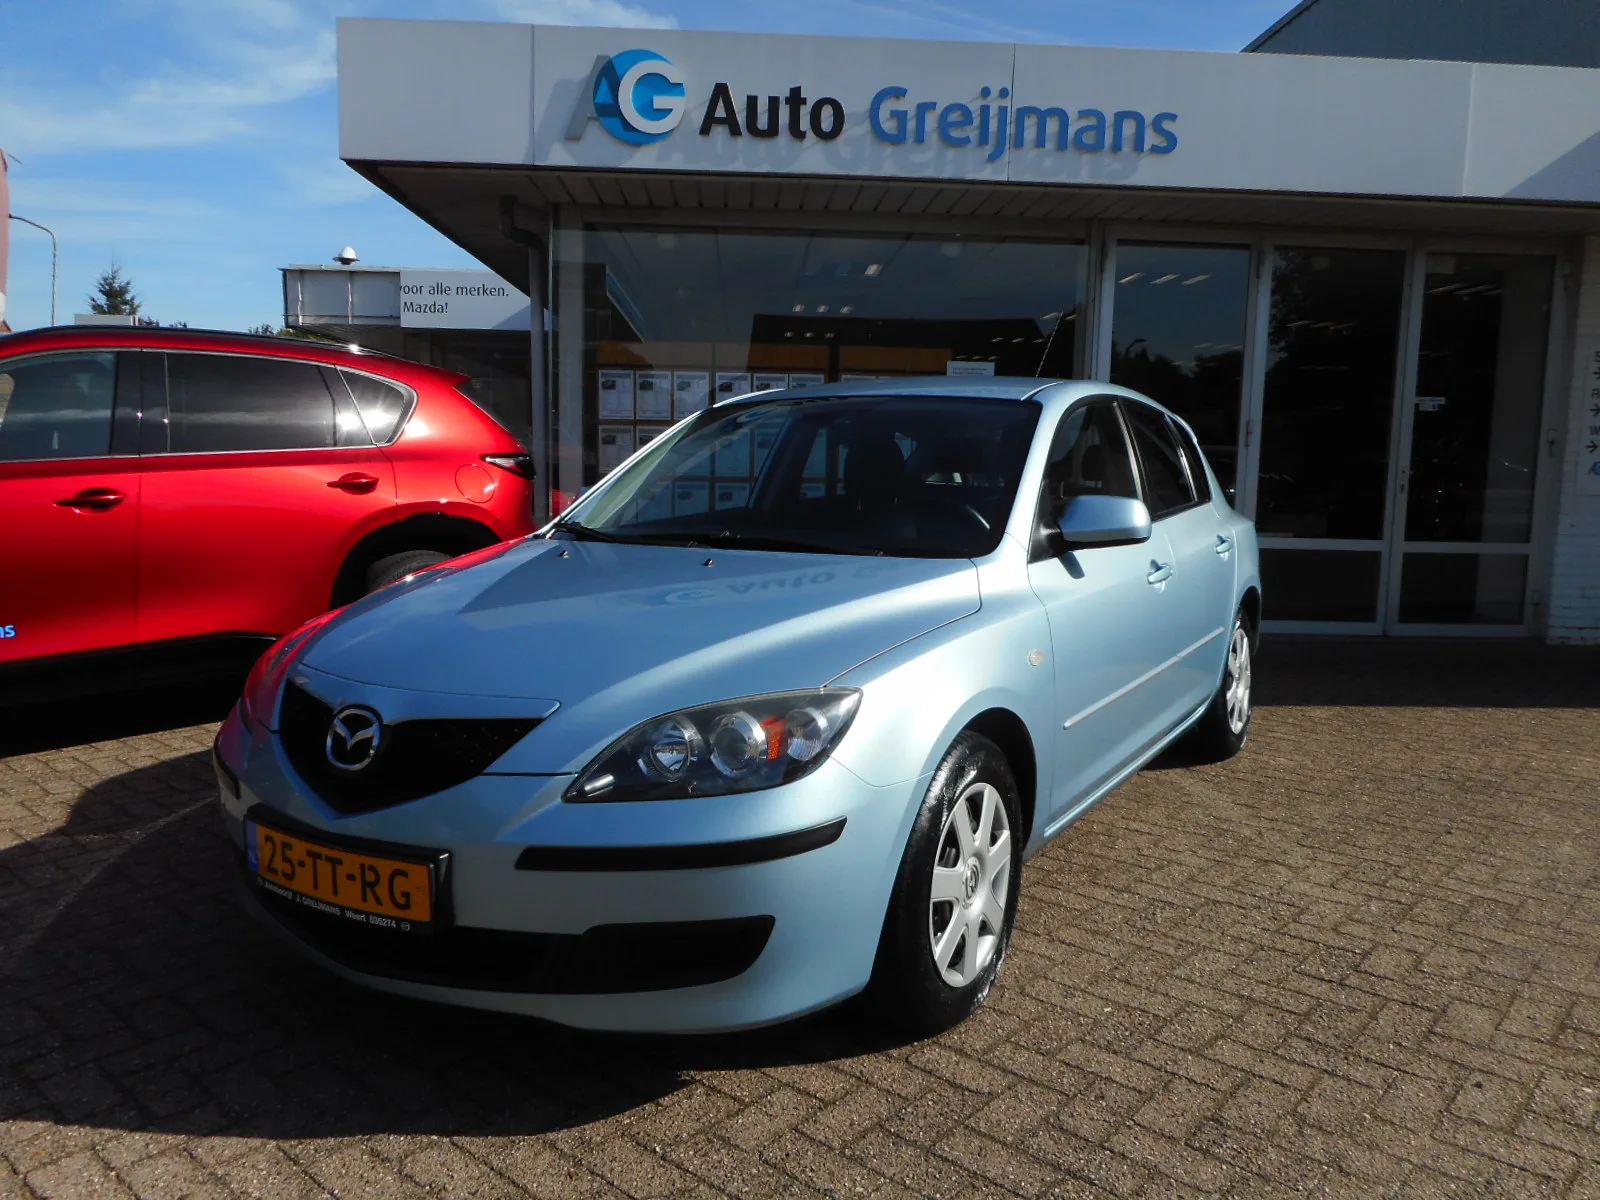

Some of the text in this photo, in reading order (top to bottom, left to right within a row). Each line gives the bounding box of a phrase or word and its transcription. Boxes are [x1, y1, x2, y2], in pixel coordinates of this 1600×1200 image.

[698, 83, 1179, 162] Auto Greijmans
[403, 301, 449, 314] Mazda!
[428, 282, 451, 296] alle
[456, 283, 509, 297] merken.
[264, 833, 413, 910] 25-TT-RG
